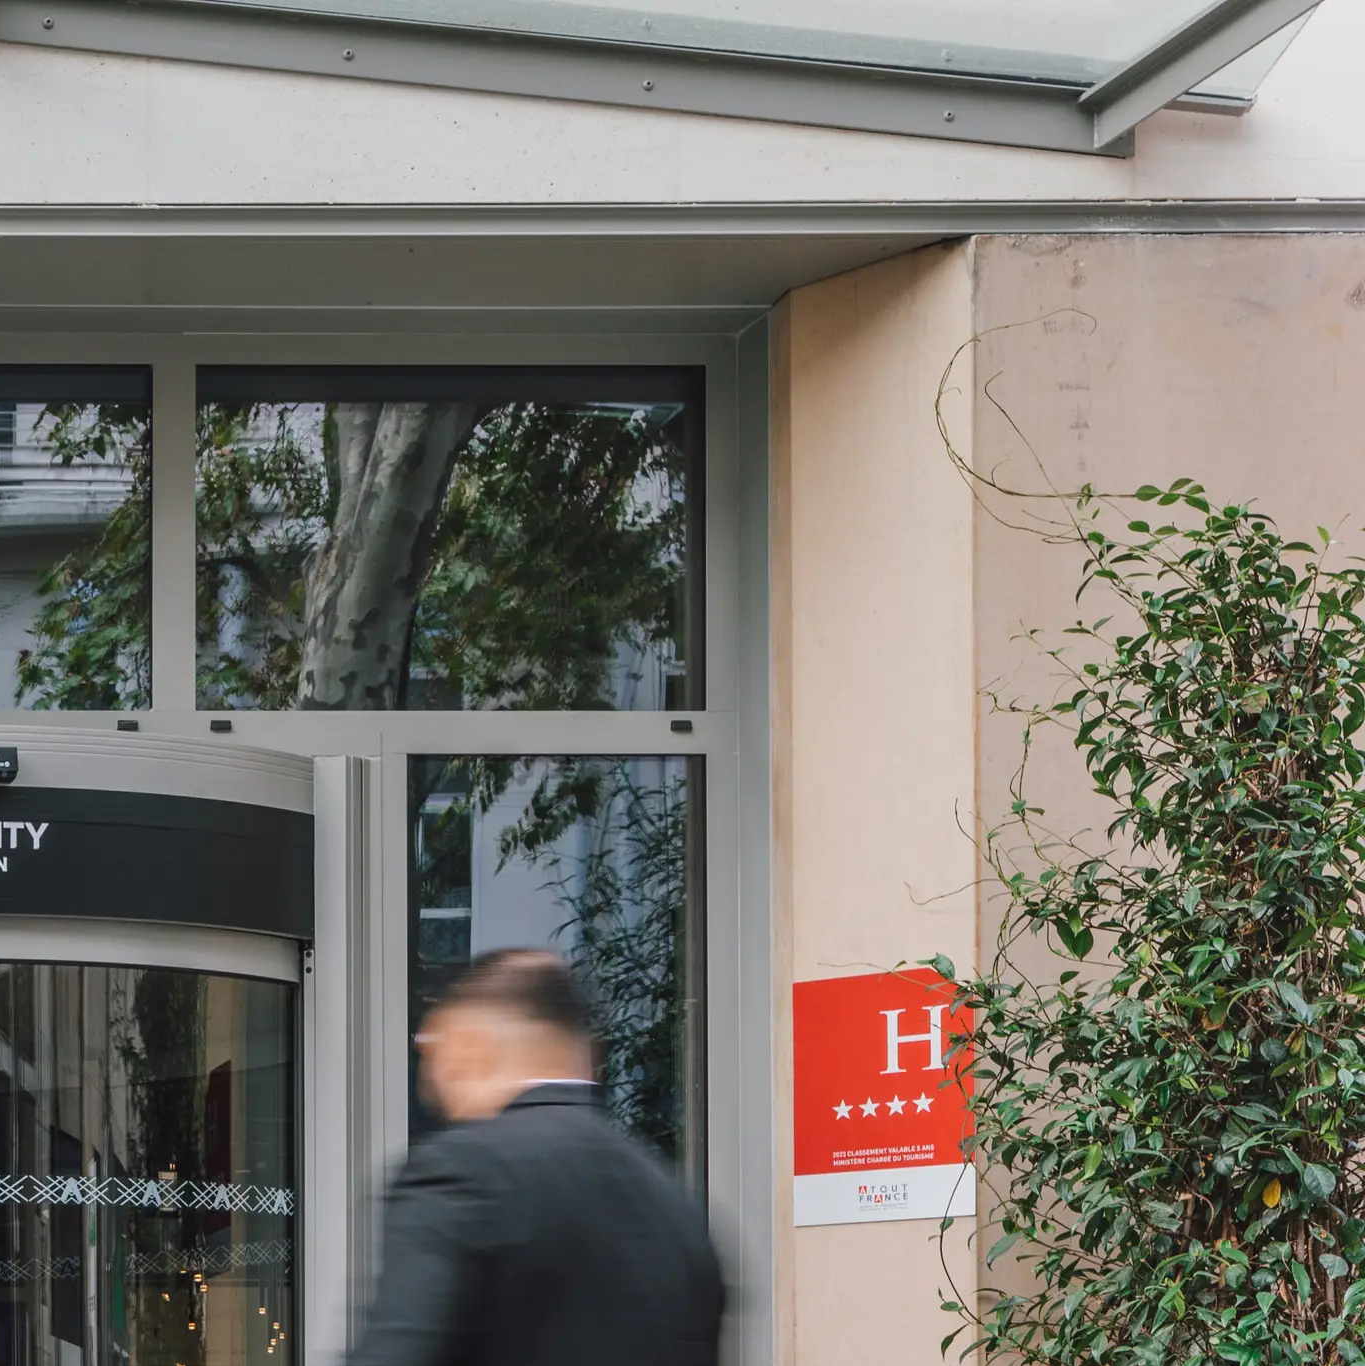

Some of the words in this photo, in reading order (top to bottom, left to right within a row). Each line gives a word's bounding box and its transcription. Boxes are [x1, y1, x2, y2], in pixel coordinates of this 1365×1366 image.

[879, 1003, 950, 1075] H
[847, 1147, 887, 1157] CLASSEMENT
[888, 1145, 916, 1154] VALABLE
[921, 1143, 935, 1151] ANS
[892, 1153, 902, 1162] DU
[903, 1152, 934, 1161] TOURISME
[859, 1192, 908, 1203] FRANCE
